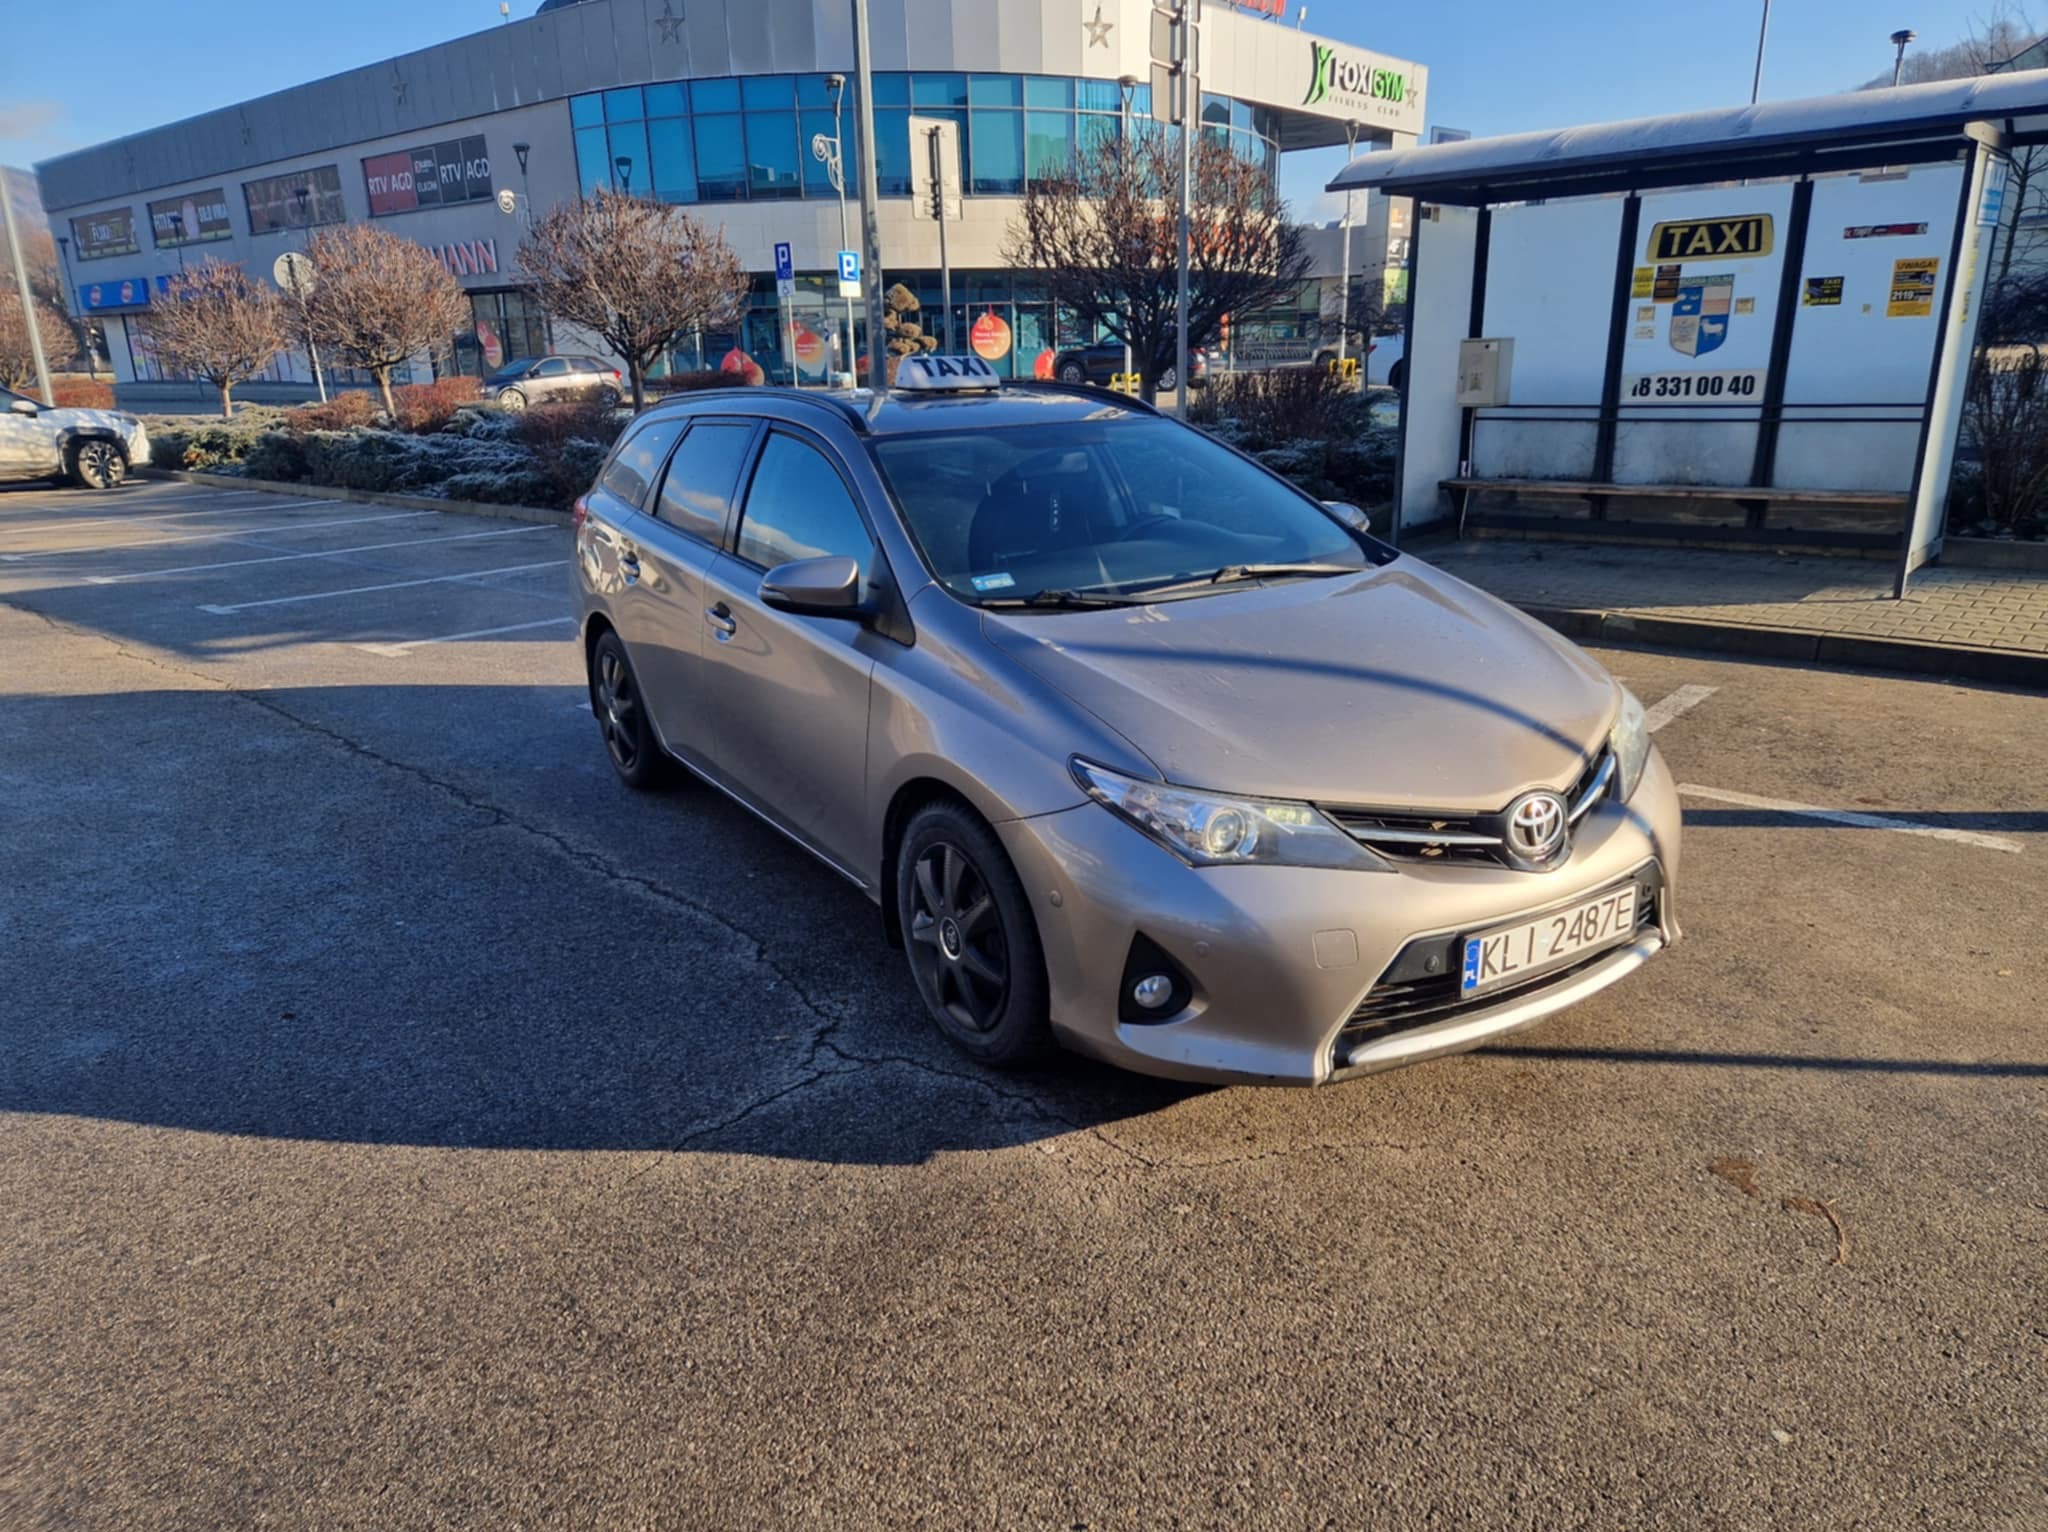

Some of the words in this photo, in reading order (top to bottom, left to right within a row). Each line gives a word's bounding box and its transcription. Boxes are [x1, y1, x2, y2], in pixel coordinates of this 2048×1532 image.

[1330, 57, 1404, 102] FOXIGYM
[1328, 95, 1368, 110] FITNESS
[439, 164, 462, 184] RTV
[466, 157, 490, 179] AGD
[368, 177, 388, 195] RTV
[391, 173, 413, 193] AGD
[1668, 221, 1758, 256] TAXI
[777, 246, 789, 269] P
[842, 254, 857, 278] P
[911, 358, 991, 377] TAXI
[1655, 376, 1692, 397] 331
[1696, 375, 1724, 396] 00
[1727, 375, 1756, 396] 40
[1480, 926, 1536, 980] KLI
[1548, 892, 1634, 957] 2487E
